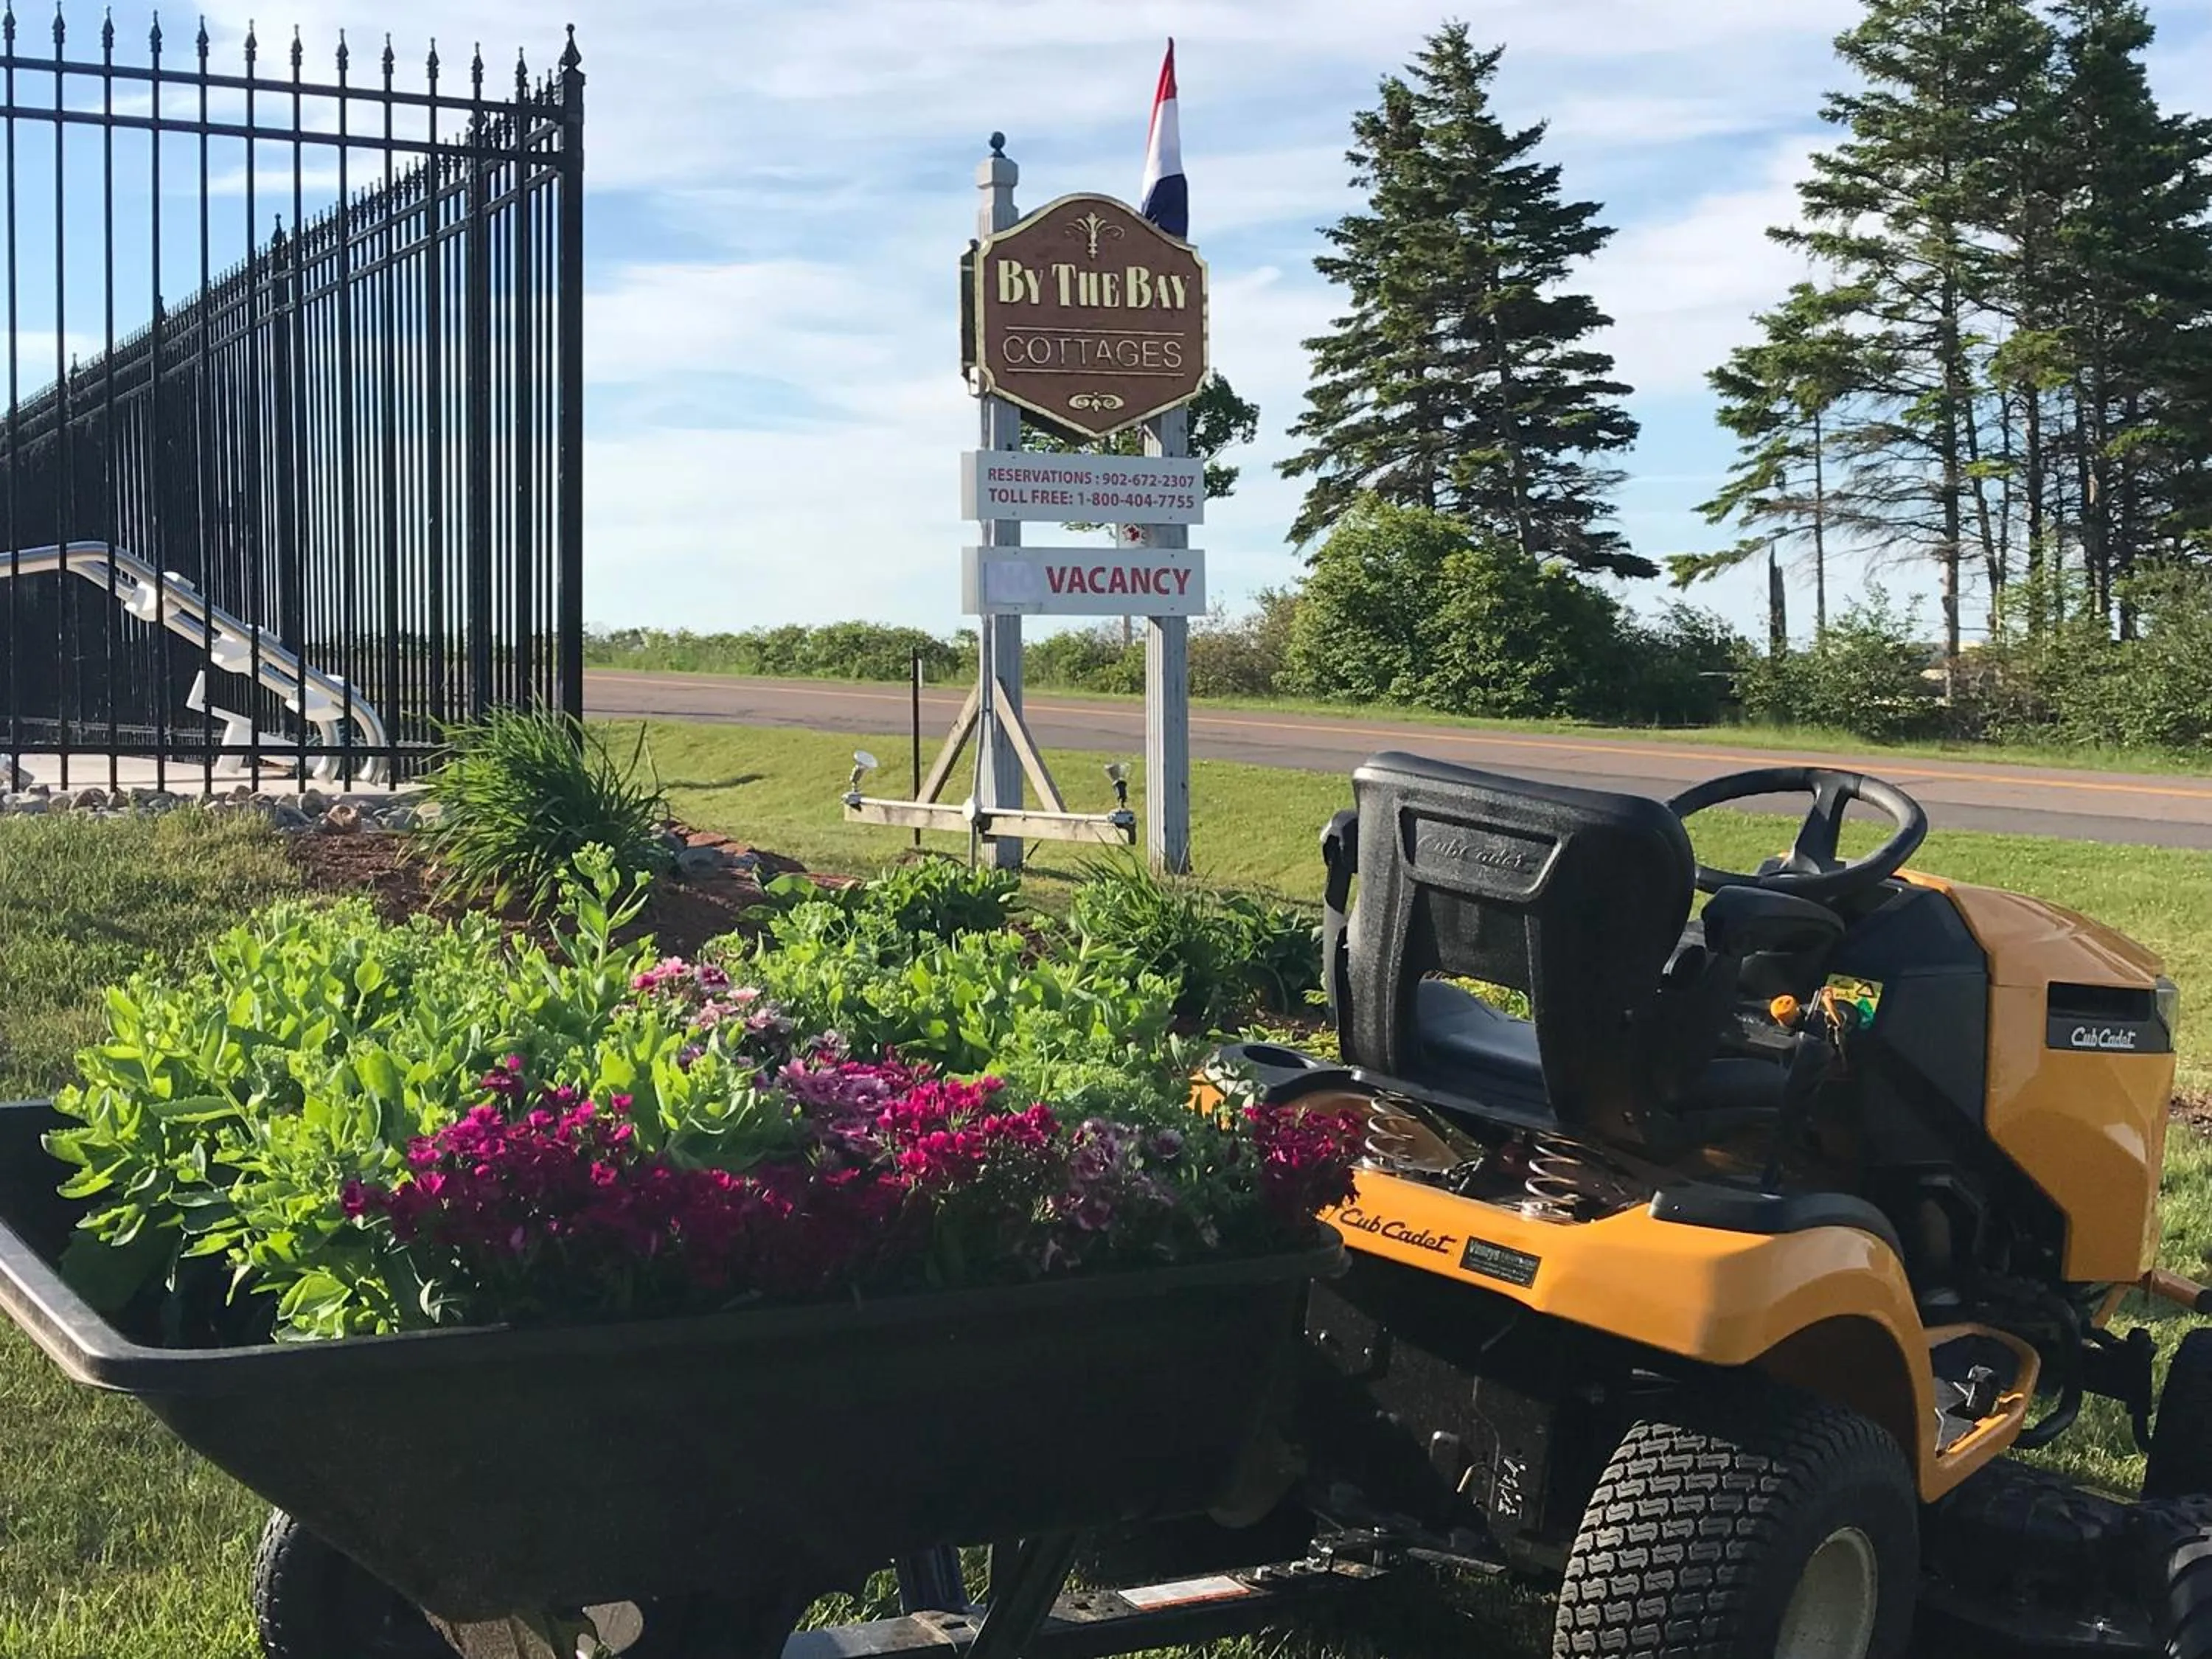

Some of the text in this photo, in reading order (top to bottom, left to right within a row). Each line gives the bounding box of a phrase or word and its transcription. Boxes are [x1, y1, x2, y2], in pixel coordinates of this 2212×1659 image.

[1003, 335, 1182, 368] COTTAGES
[1102, 473, 1194, 487] 902-672-2307
[989, 487, 1194, 509] TOLL FREE: 1-800-404-7755
[1046, 566, 1192, 595] VACANCY
[1339, 1208, 1381, 1234] Cub
[1381, 1221, 1457, 1254] Cadet
